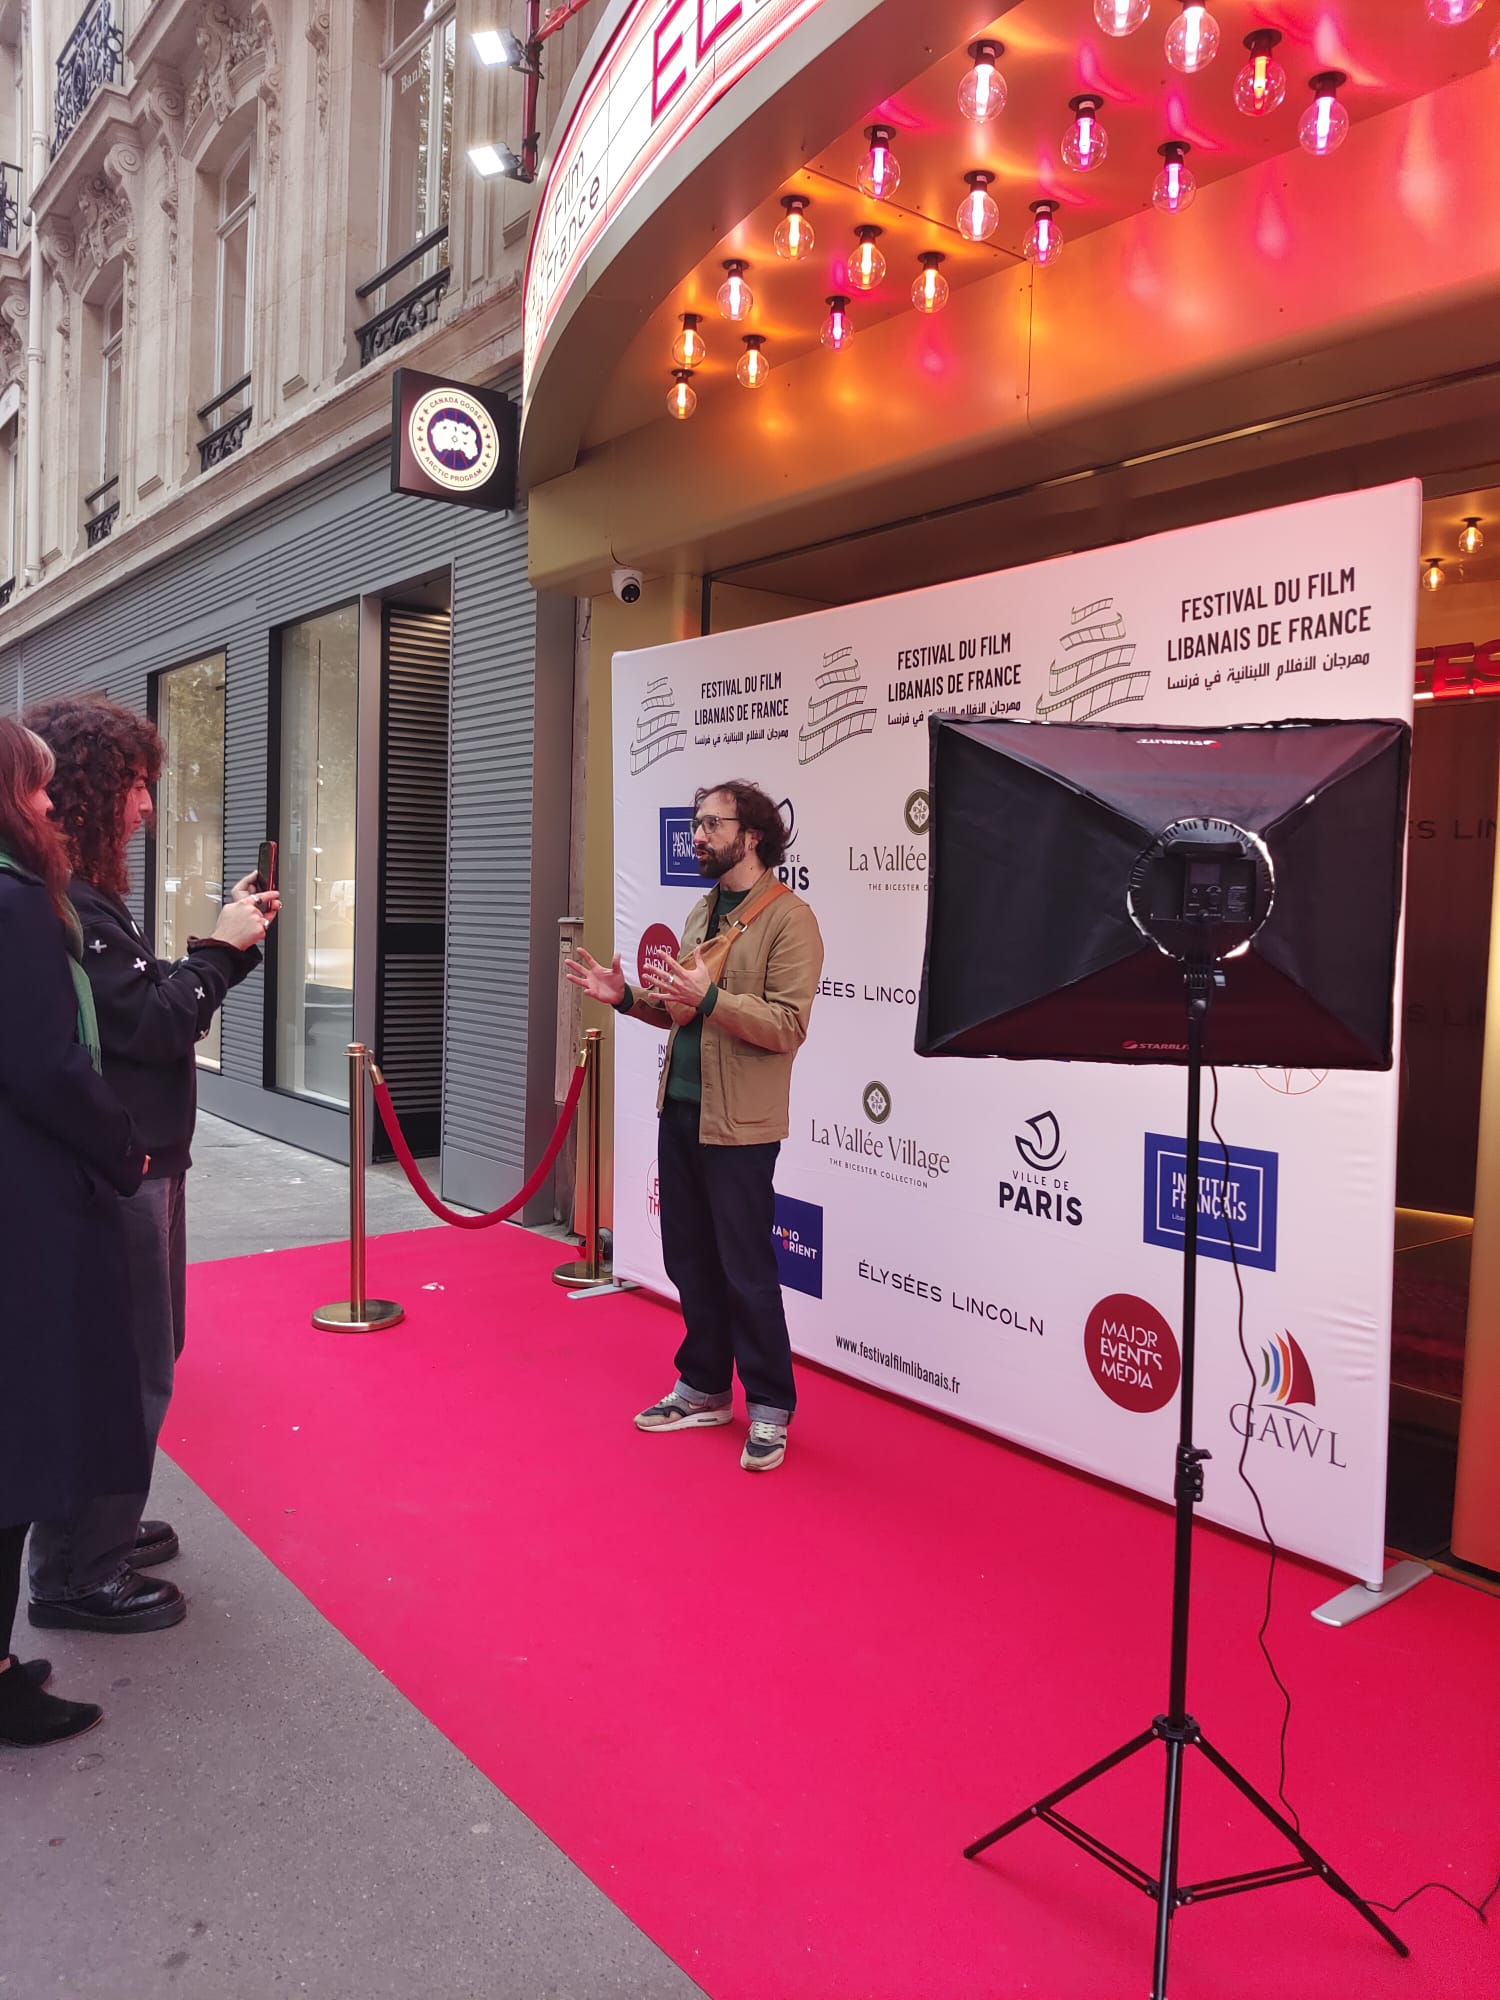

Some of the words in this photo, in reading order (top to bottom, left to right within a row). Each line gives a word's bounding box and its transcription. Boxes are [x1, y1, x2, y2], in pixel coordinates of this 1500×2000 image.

[555, 151, 585, 236] Film
[547, 175, 600, 300] France
[430, 397, 459, 408] CANADA
[460, 400, 482, 420] GOOSE
[425, 456, 449, 479] ARCTIC
[450, 469, 482, 481] PROGRAM
[1181, 585, 1268, 623] FESTIVAL
[1274, 578, 1300, 606] DU
[1308, 567, 1355, 599] FILM
[1168, 626, 1251, 662] LIBANAIS
[1257, 621, 1282, 648] DE
[1288, 605, 1372, 643] FRANCE
[898, 643, 955, 671] FESTIVAL
[959, 638, 976, 661] DU
[981, 632, 1011, 657] FILM
[1323, 652, 1370, 672] مهرجان
[701, 678, 742, 699] FESTIVAL
[745, 675, 757, 693] DU
[760, 672, 781, 691] FILM
[888, 676, 943, 702] LIBANAIS
[947, 673, 963, 694] DE
[968, 664, 1022, 691] FRANCE
[1167, 673, 1199, 690] فرنسا
[1204, 670, 1221, 691] في
[1227, 662, 1270, 685] اللبنانية
[694, 706, 735, 725] LIBANAIS
[737, 704, 748, 721] DE
[751, 698, 789, 720] FRANCE
[888, 712, 910, 726] فرنسا
[913, 710, 924, 727] في
[990, 700, 1021, 715] مهرجان
[790, 854, 801, 863] DE
[849, 846, 869, 871] La
[873, 844, 927, 871] Vallée
[779, 866, 809, 890] RIS
[868, 883, 882, 891] THE
[885, 883, 920, 891] BICESTER
[864, 984, 917, 1005] LINCO
[811, 1119, 830, 1146] La
[834, 1124, 884, 1158] Vallée
[888, 1136, 950, 1178] Village
[829, 1158, 842, 1168] THE
[844, 1161, 878, 1176] BICESTER
[880, 1170, 928, 1189] COLLECTION
[1012, 1169, 1047, 1186] VILLE
[1054, 1179, 1069, 1191] DE
[1172, 1171, 1240, 1203] INTITUT
[999, 1181, 1083, 1226] PARIS
[858, 1259, 942, 1302] ÉLYSÉES
[952, 1292, 1044, 1336] LINCOLN
[1101, 1318, 1159, 1348] MAJOR
[836, 1334, 960, 1394] www.festivalfilmlibanais.fr
[1100, 1336, 1164, 1371] EVENTS
[1101, 1358, 1153, 1390] MEDIA
[1229, 1403, 1347, 1468] GAWL
